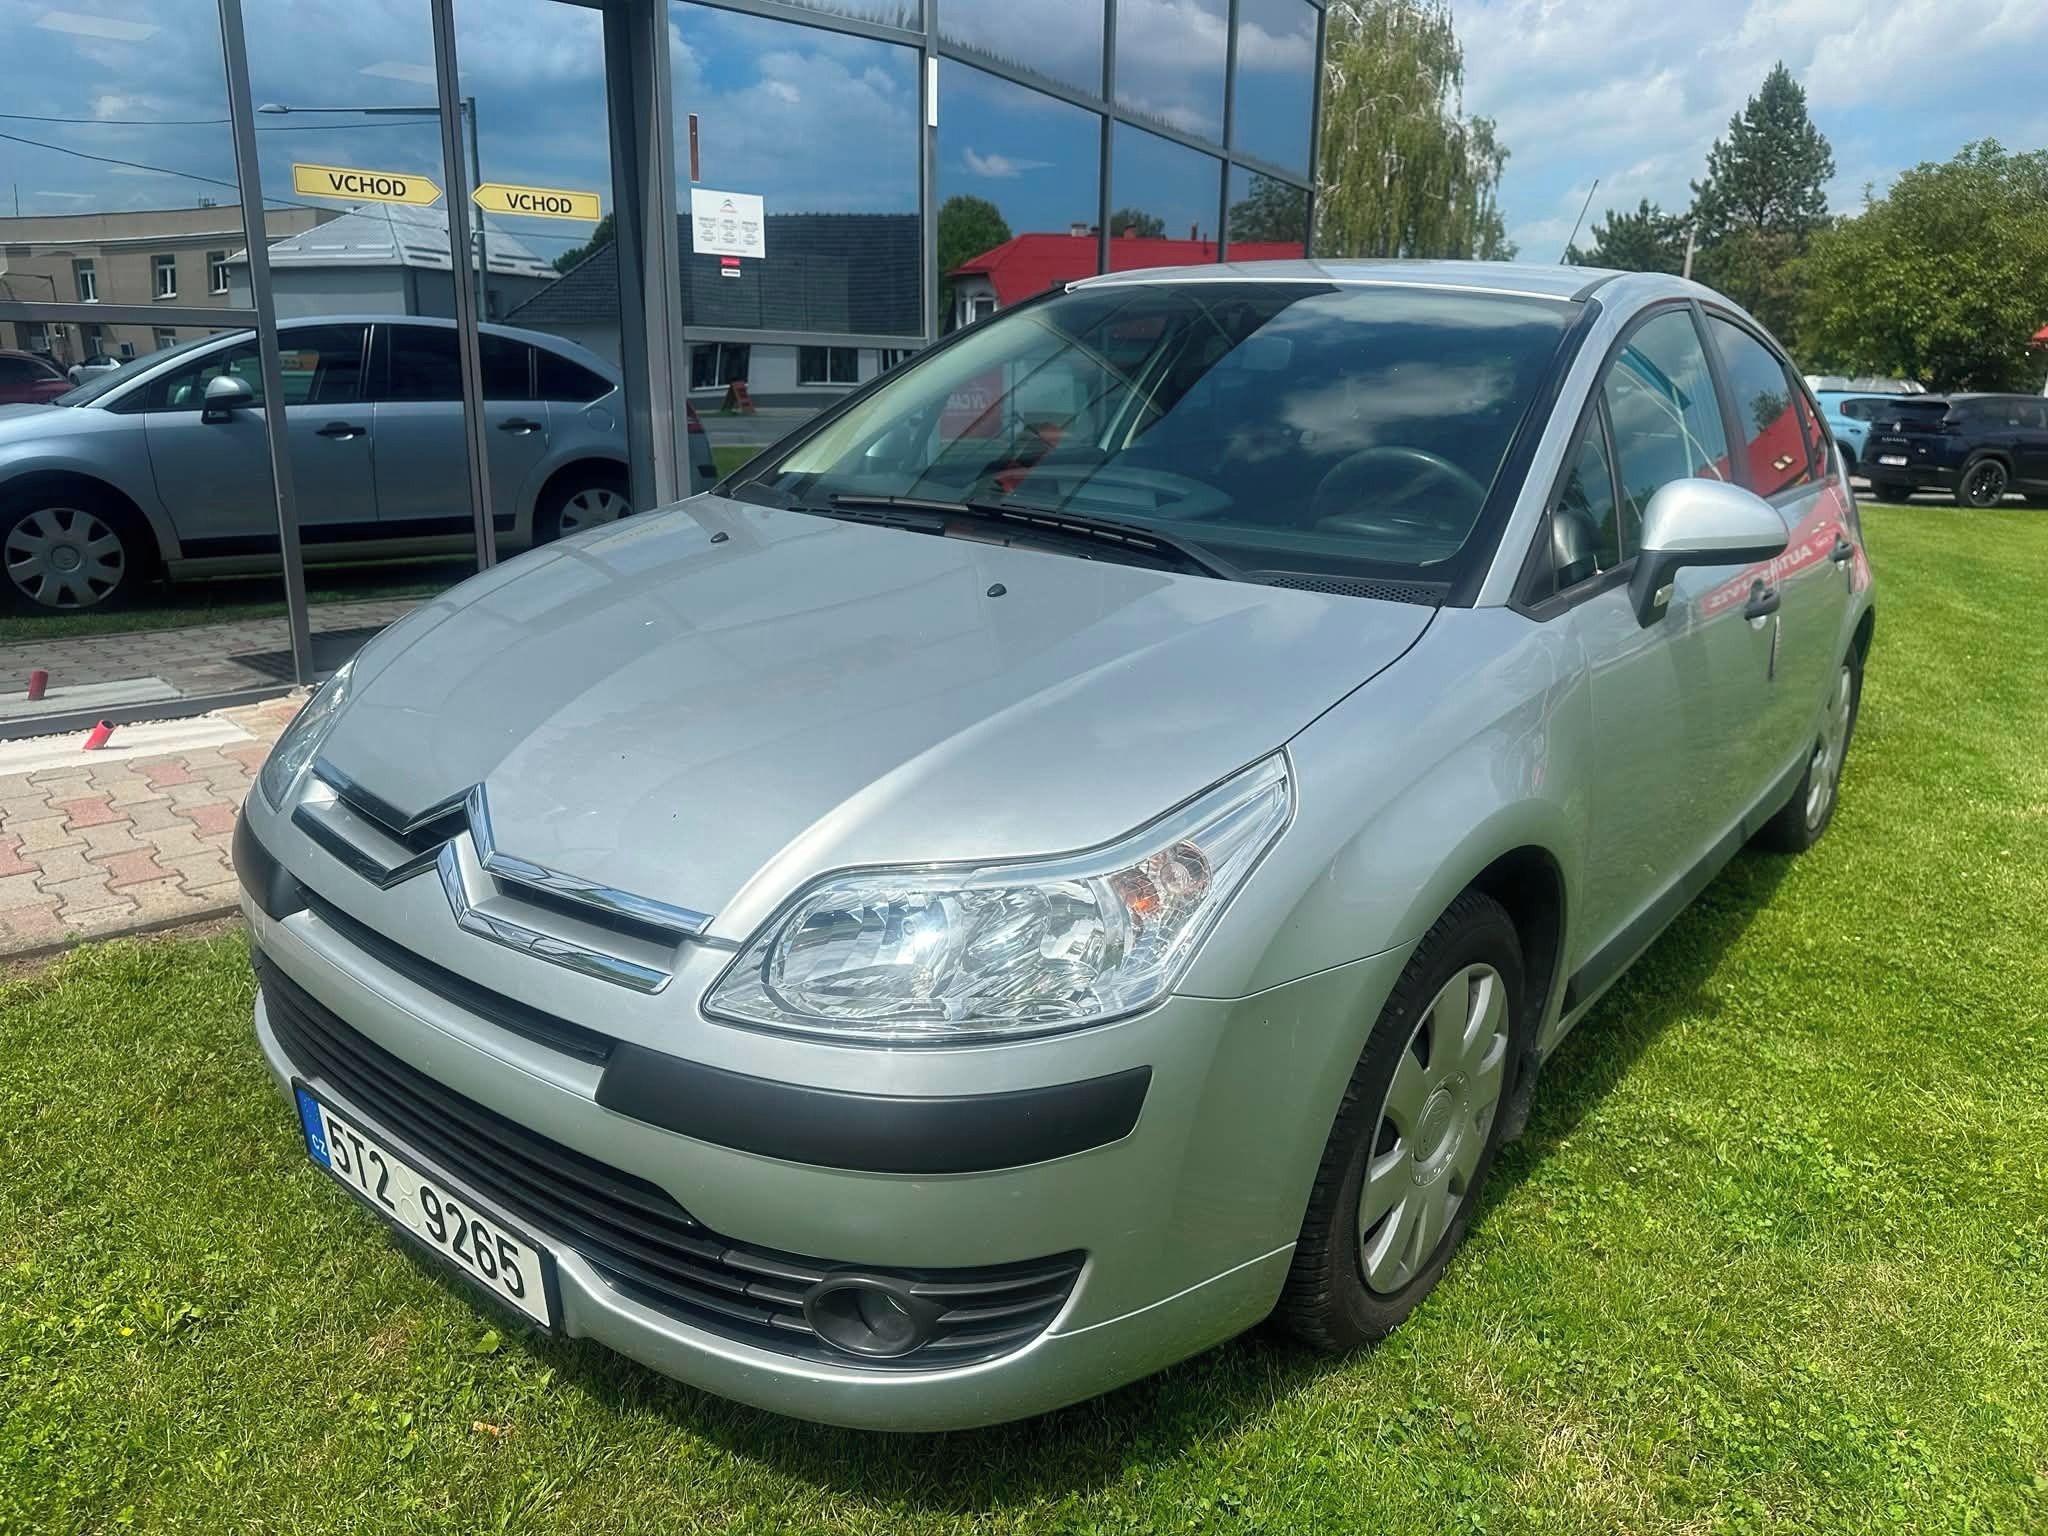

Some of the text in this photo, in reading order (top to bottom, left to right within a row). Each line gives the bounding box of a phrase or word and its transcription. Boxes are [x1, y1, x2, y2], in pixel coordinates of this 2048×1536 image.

[329, 173, 406, 197] VCHOD
[505, 193, 572, 214] VCHOD
[311, 1134, 328, 1157] CZ
[326, 1116, 526, 1299] 5T2 9265
